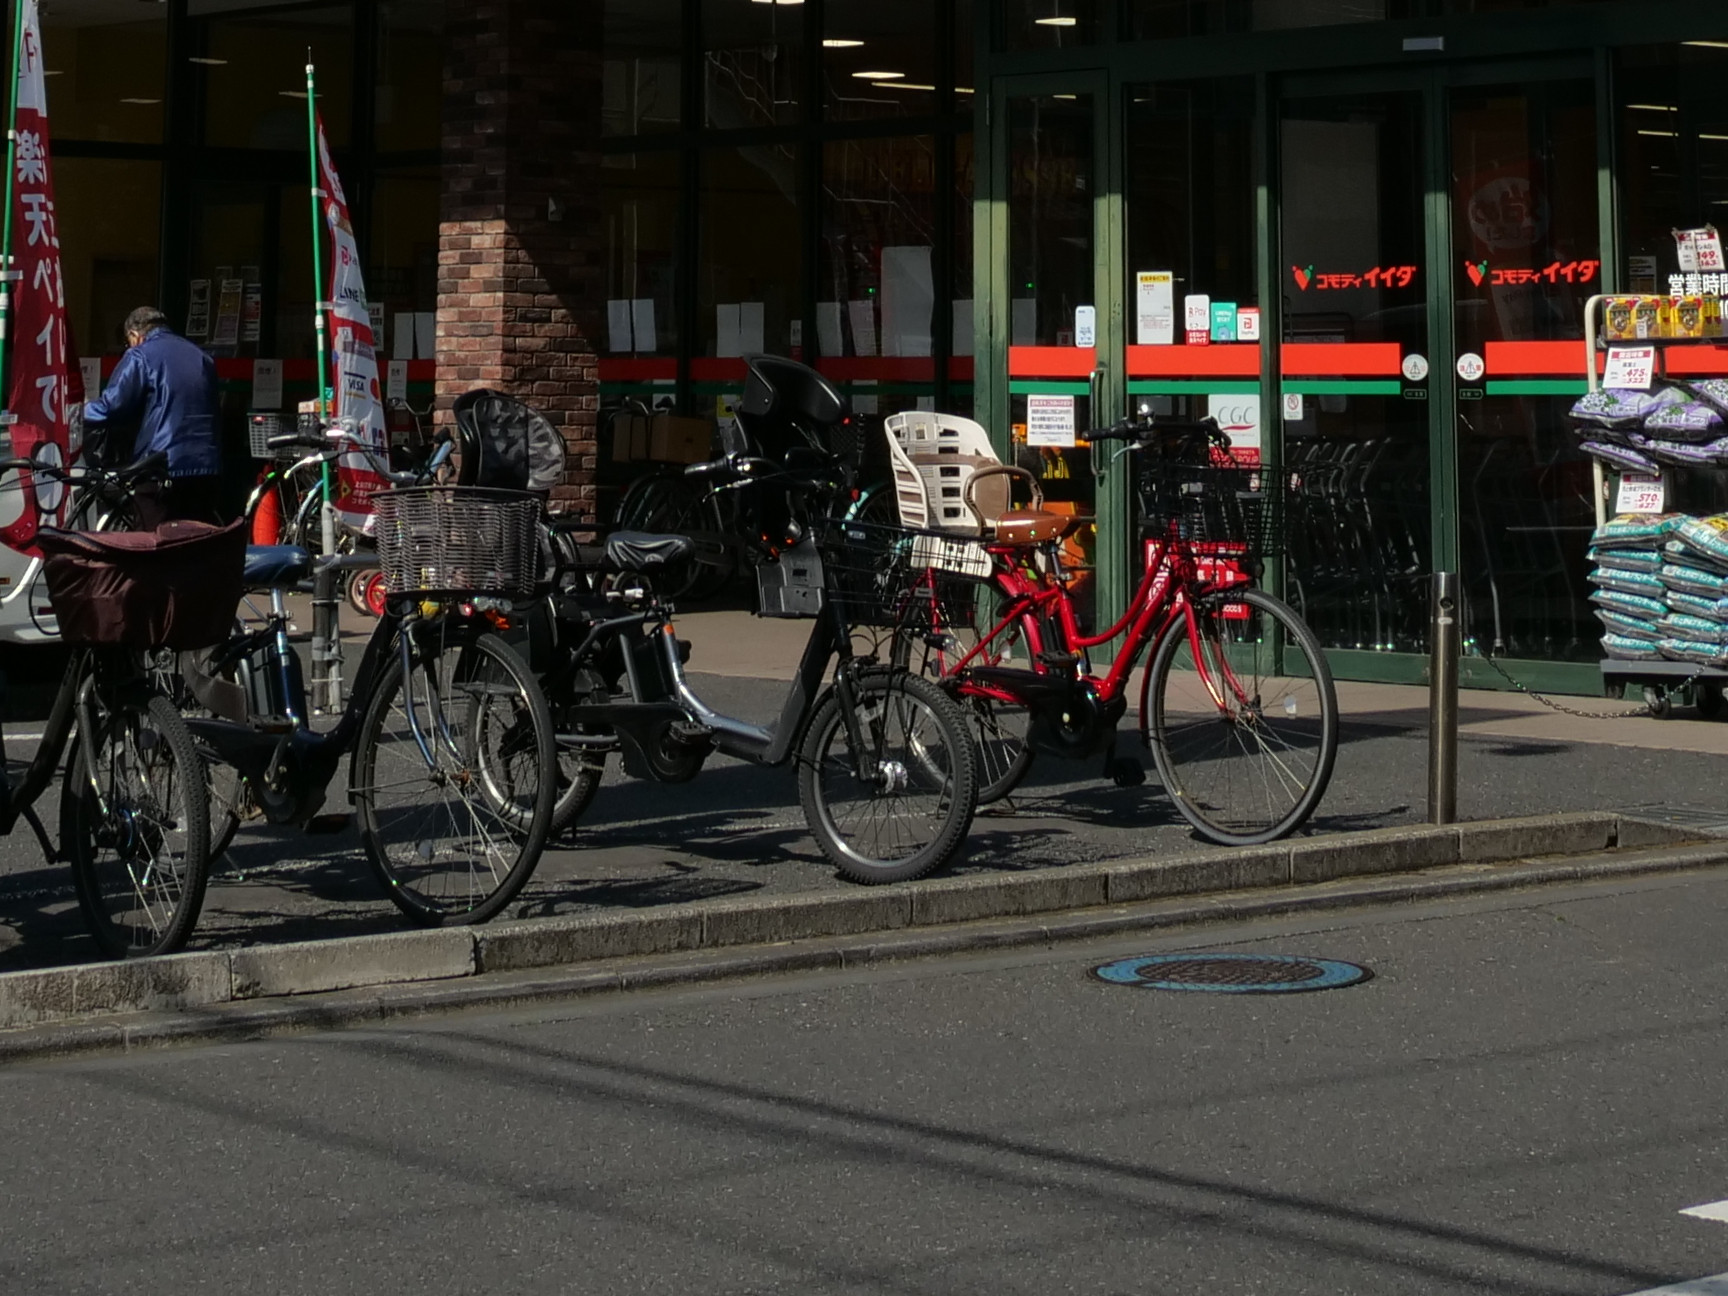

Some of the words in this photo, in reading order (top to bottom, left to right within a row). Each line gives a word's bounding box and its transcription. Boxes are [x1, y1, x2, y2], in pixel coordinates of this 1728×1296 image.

[1316, 265, 1417, 289] コモディイイダ
[1491, 260, 1600, 284] コモディイイダ
[347, 378, 365, 393] VISA
[1217, 406, 1254, 426] CGC
